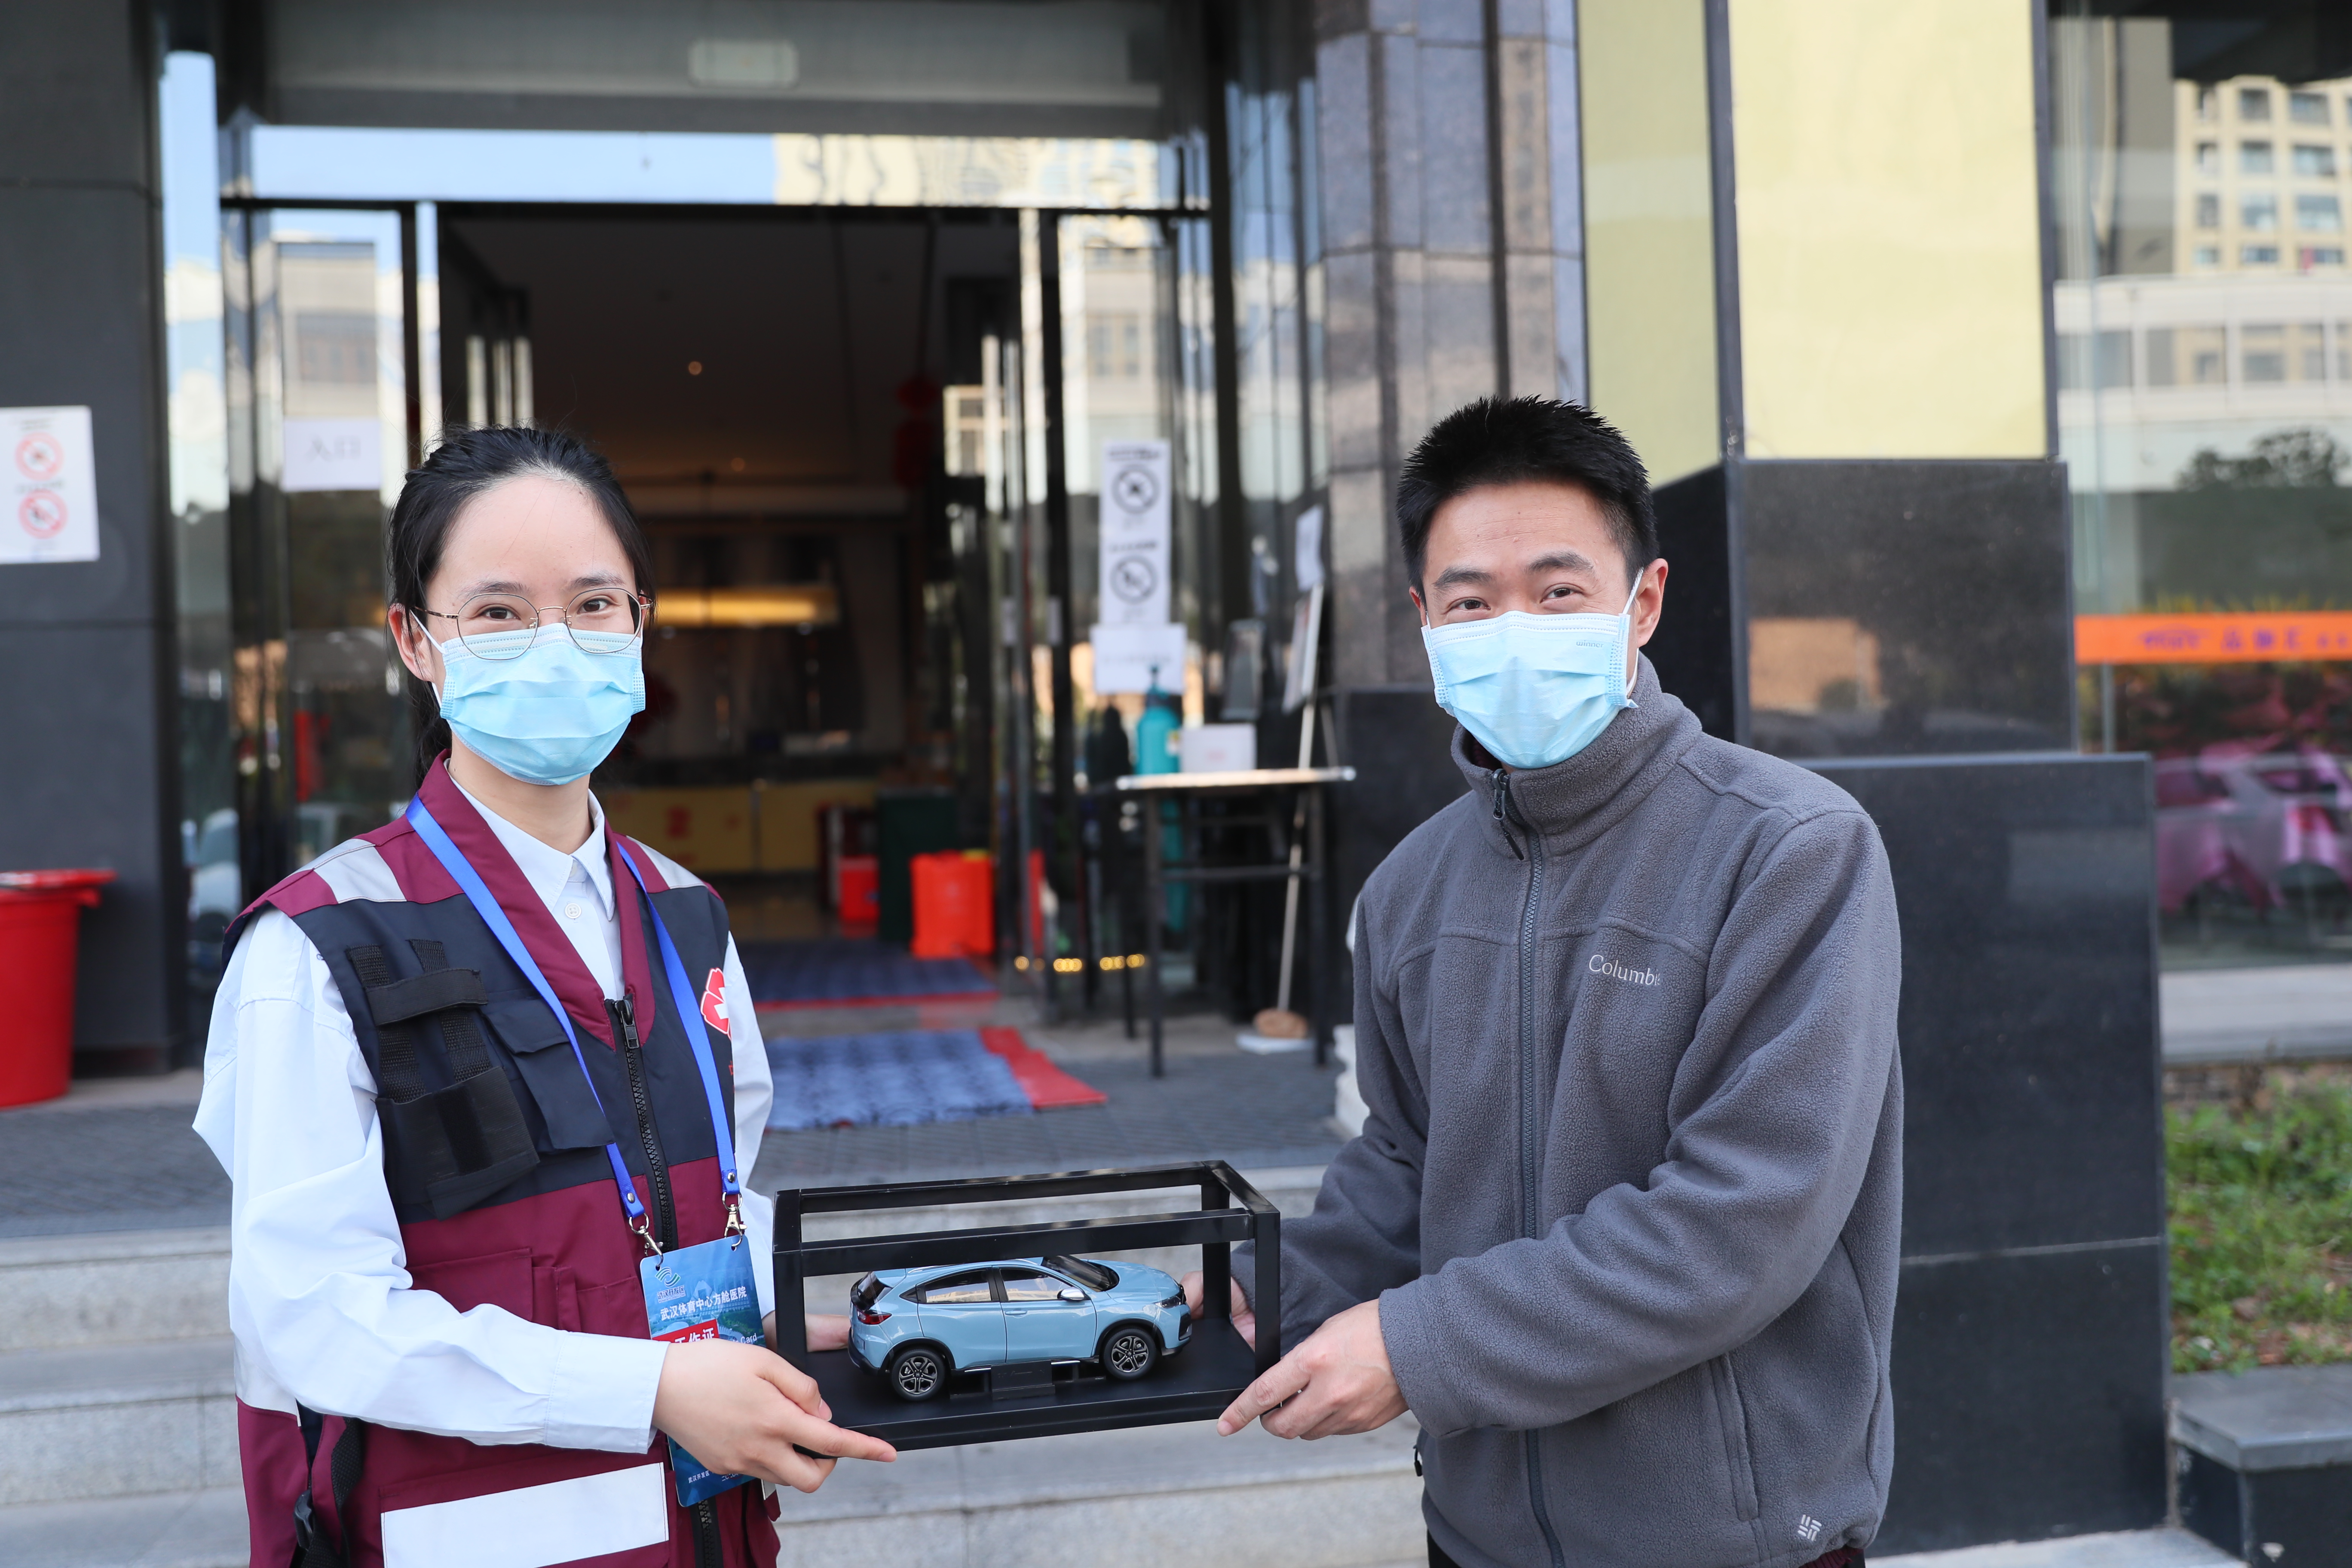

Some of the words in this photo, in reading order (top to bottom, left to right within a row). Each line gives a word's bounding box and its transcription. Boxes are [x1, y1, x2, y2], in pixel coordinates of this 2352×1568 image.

[1589, 954, 1660, 986] Columbi
[656, 1285, 685, 1299] 武汉开发区
[660, 1286, 747, 1321] 武汉体育中心方舱医院
[740, 1332, 757, 1344] Card
[688, 1470, 710, 1483] 武汉开发区
